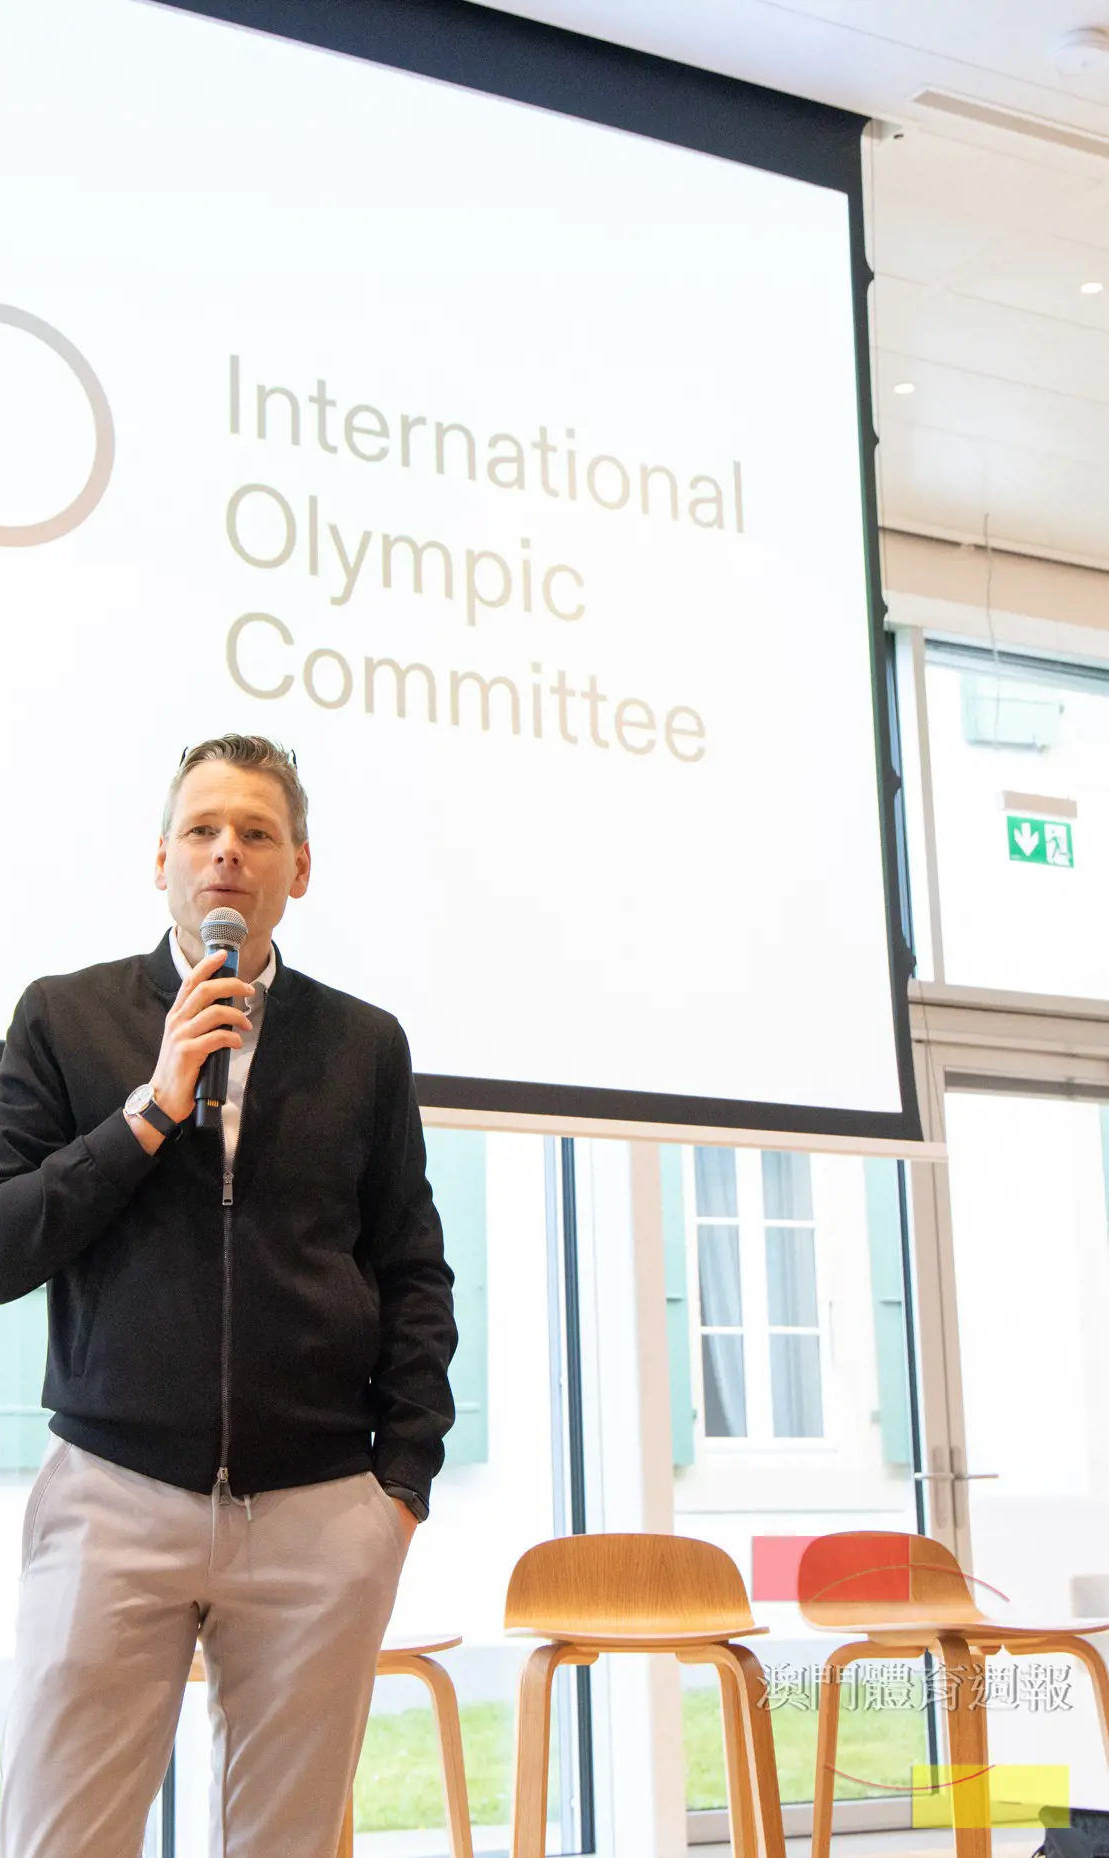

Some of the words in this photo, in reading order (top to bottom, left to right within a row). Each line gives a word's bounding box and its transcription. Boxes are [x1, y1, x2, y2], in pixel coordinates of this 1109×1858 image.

[229, 354, 745, 534] International
[226, 482, 587, 627] Olympic
[225, 611, 707, 763] Committee
